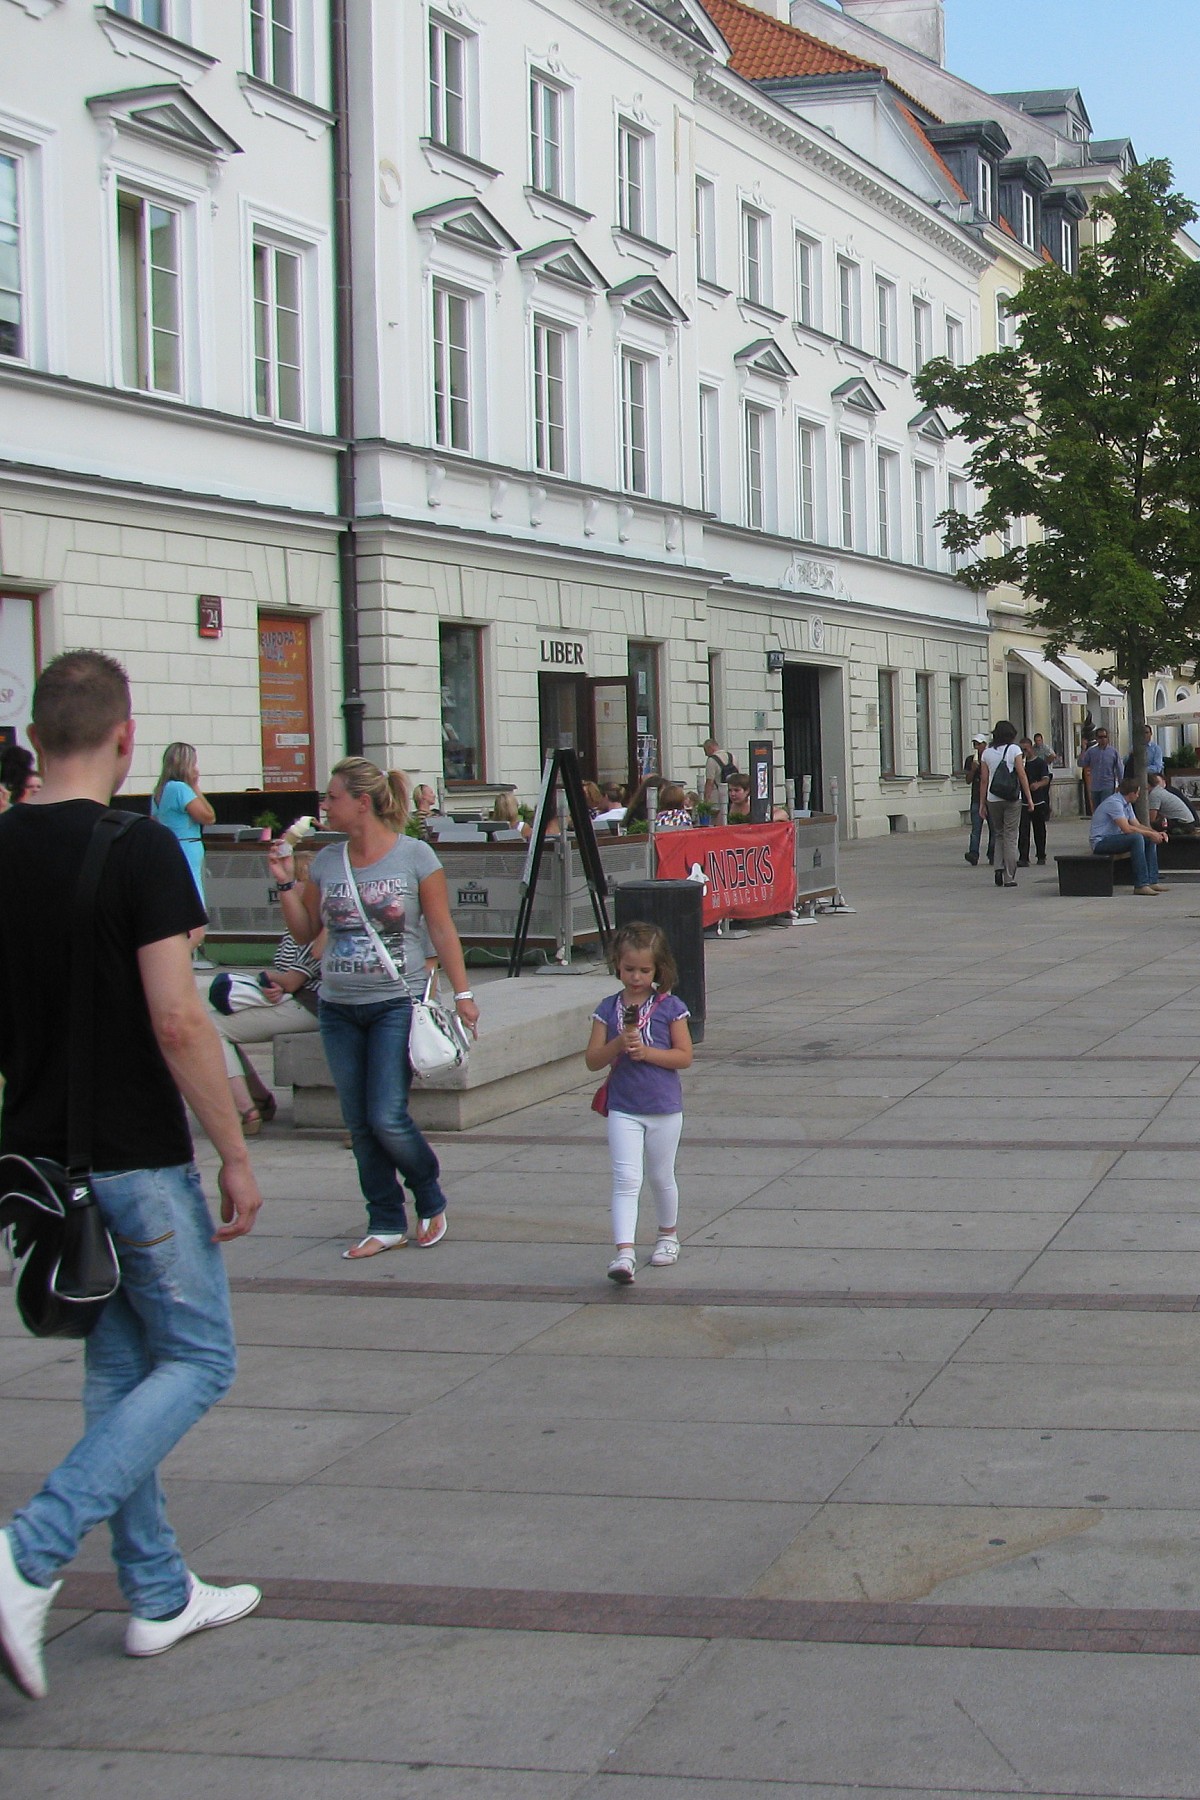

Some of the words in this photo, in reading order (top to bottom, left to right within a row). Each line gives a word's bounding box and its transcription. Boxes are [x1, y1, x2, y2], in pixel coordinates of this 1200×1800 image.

[206, 609, 219, 628] 24
[261, 630, 297, 648] EUROPA
[540, 639, 584, 665] LIBER
[460, 892, 485, 903] LECH
